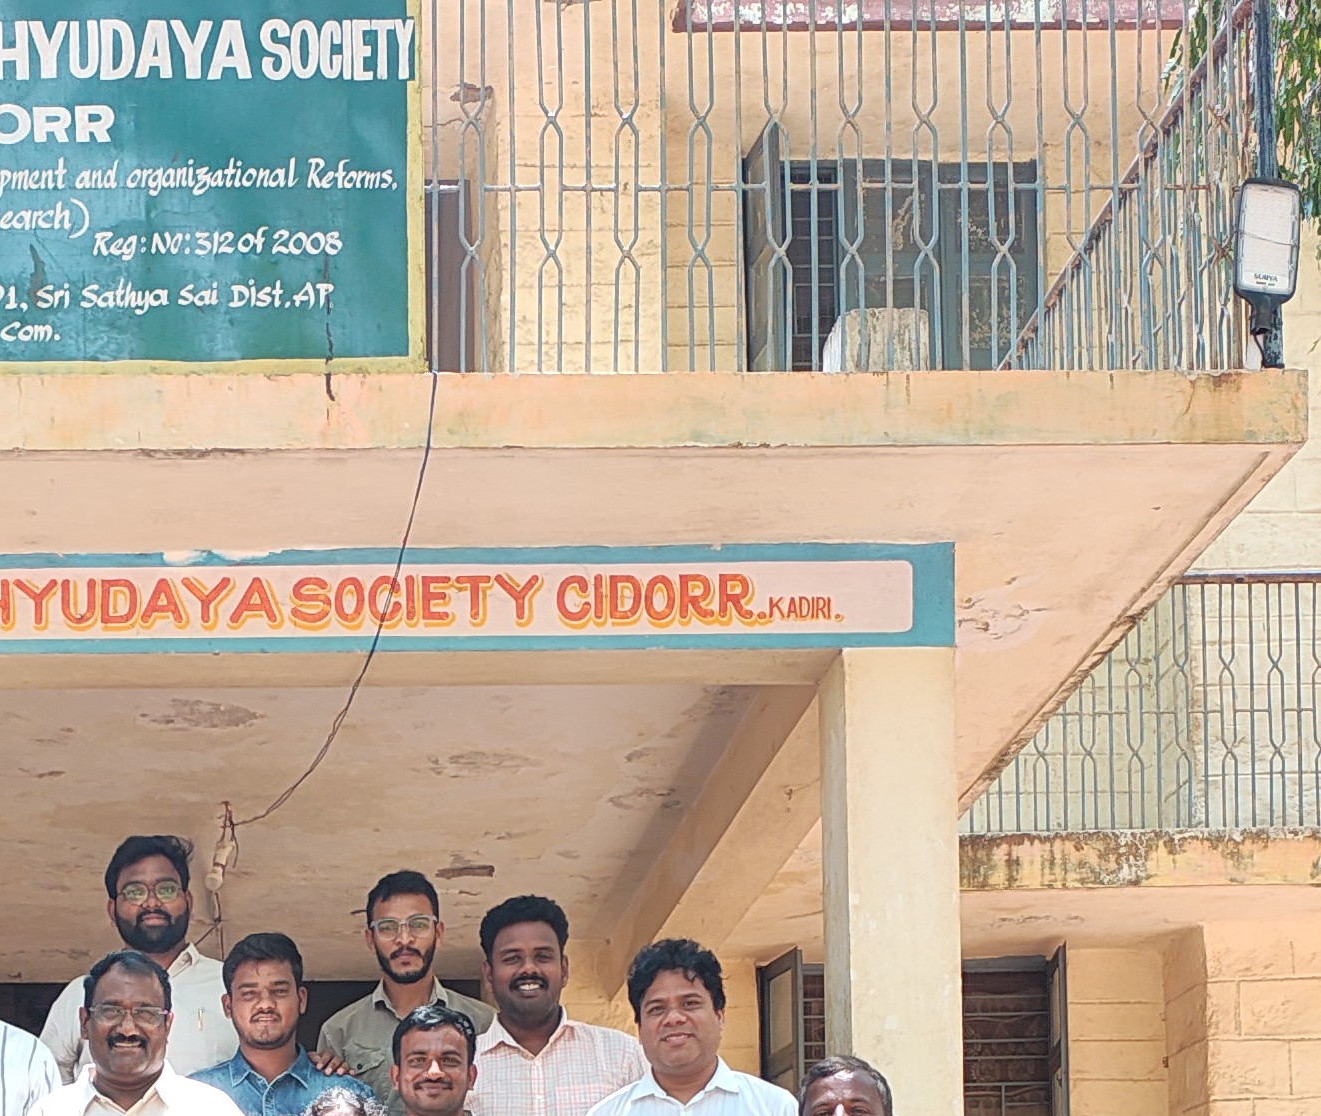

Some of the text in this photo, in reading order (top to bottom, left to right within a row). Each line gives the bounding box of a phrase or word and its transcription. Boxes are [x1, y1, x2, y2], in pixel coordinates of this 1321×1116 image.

[259, 18, 415, 81] SOCIETY
[75, 159, 119, 190] and
[125, 157, 299, 197] organizational
[271, 229, 344, 256] 2008
[35, 283, 71, 309] Sri
[79, 277, 171, 316] Sathya
[289, 573, 545, 630] SOCIETY
